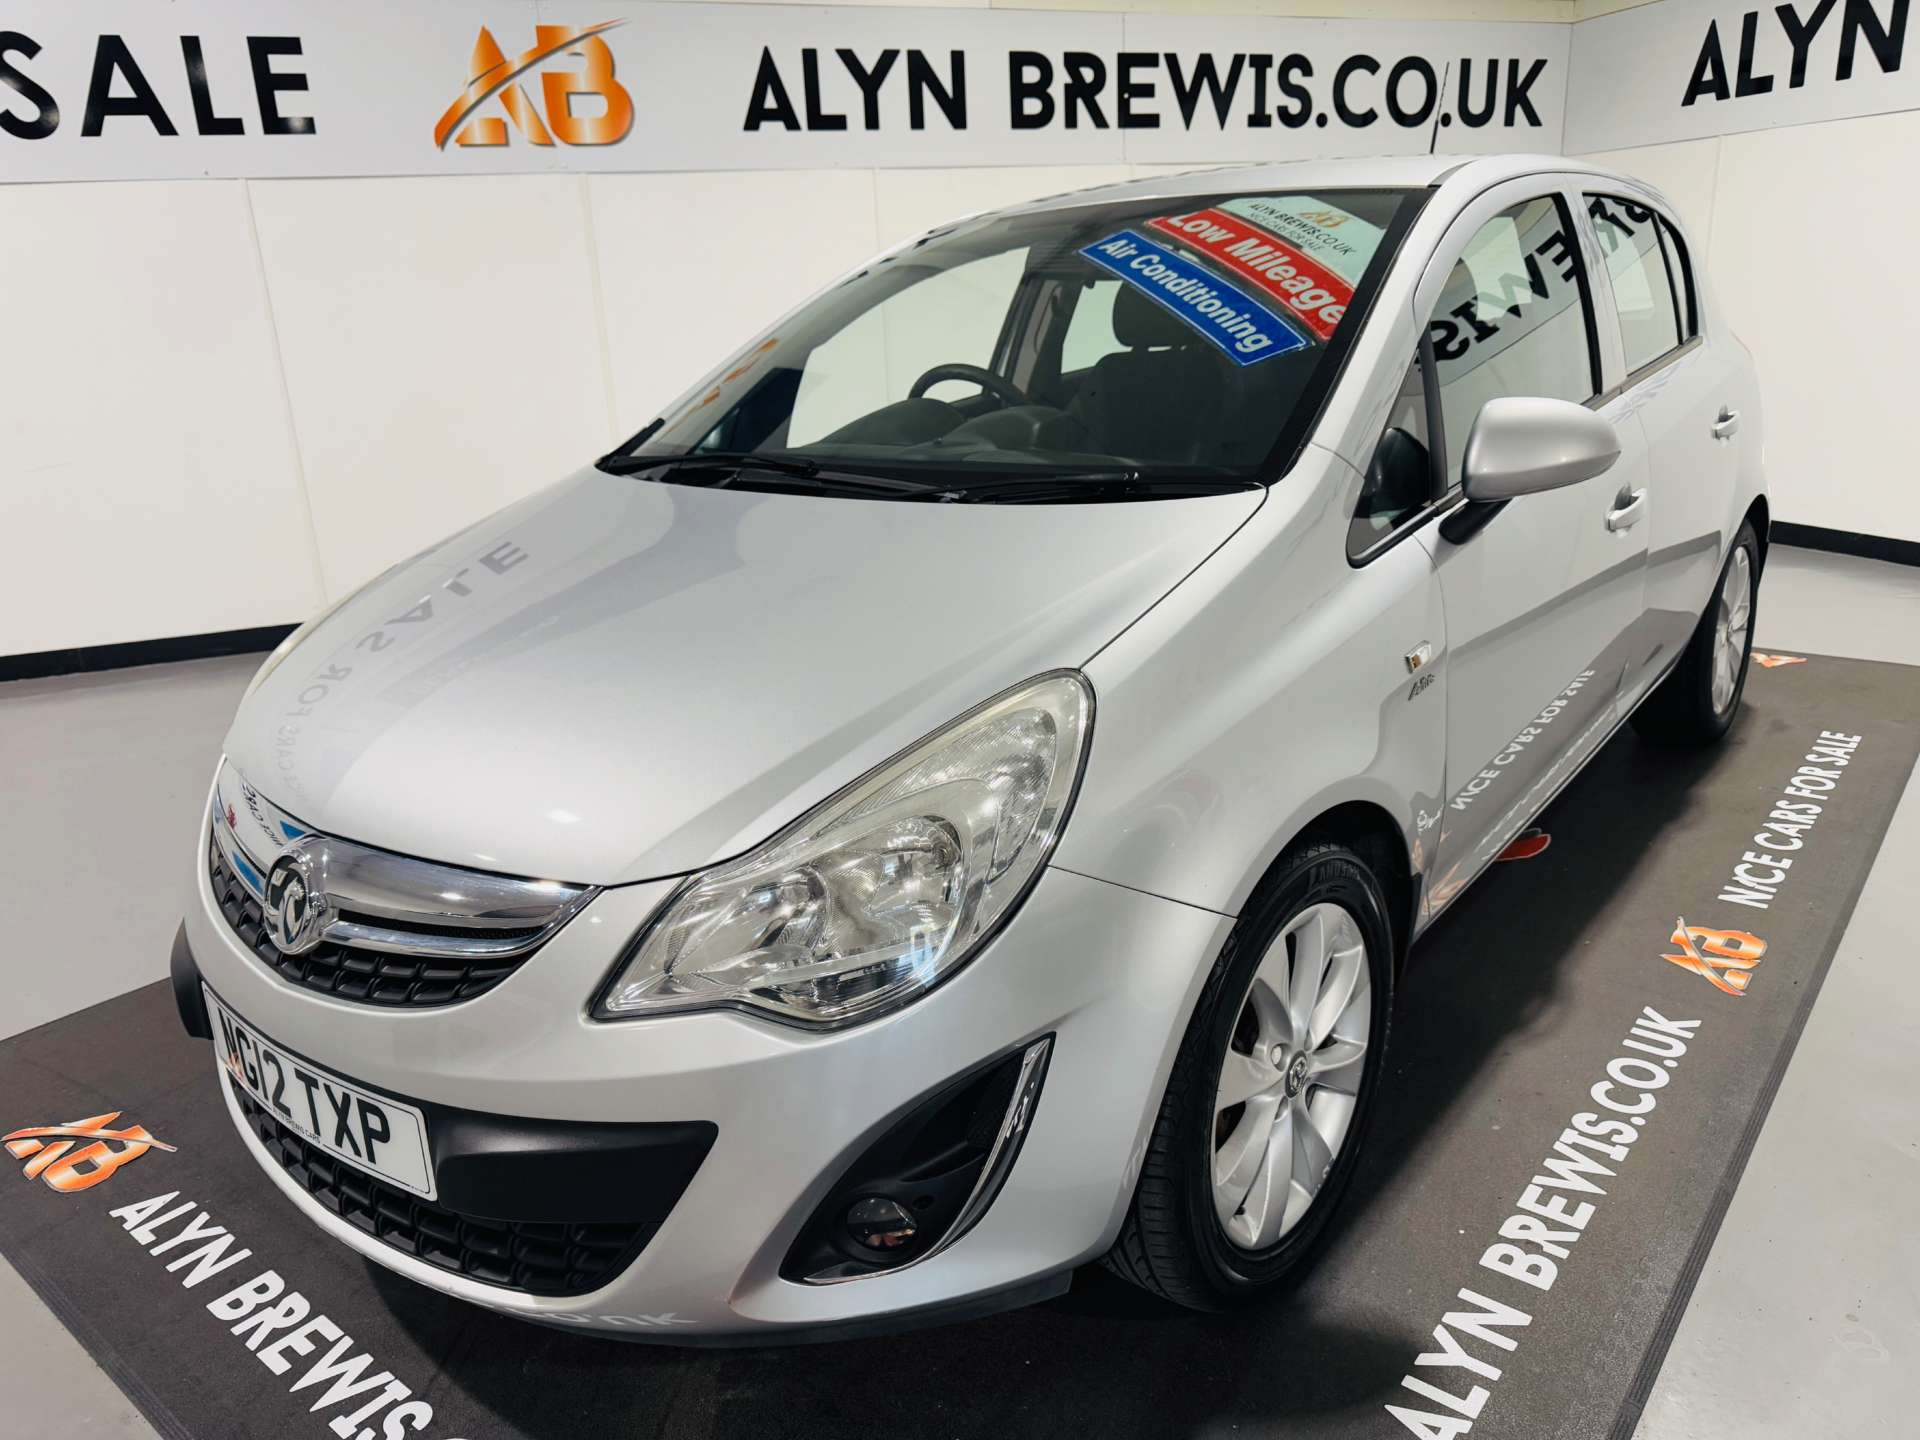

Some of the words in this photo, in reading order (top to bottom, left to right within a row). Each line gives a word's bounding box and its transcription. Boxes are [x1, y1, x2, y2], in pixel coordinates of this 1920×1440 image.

[0, 30, 316, 140] SALE
[743, 46, 966, 131] ALYN
[1008, 51, 1548, 131] BREWIS.CO.UK
[1681, 0, 1911, 107] ALYN
[1098, 239, 1138, 260] Air
[1129, 253, 1274, 354] Conditioning
[1224, 238, 1348, 323] Mileage
[1784, 766, 1842, 800] FOR
[1805, 730, 1862, 766] SALE
[1754, 800, 1822, 851] CARS
[1717, 851, 1793, 909] NICE
[217, 1006, 293, 1118] NG12
[294, 1067, 391, 1165] TXP
[109, 1190, 253, 1289] ALYN
[1384, 1287, 1533, 1440] ALYN
[1478, 1006, 1702, 1291] BREWIS.CO.UK
